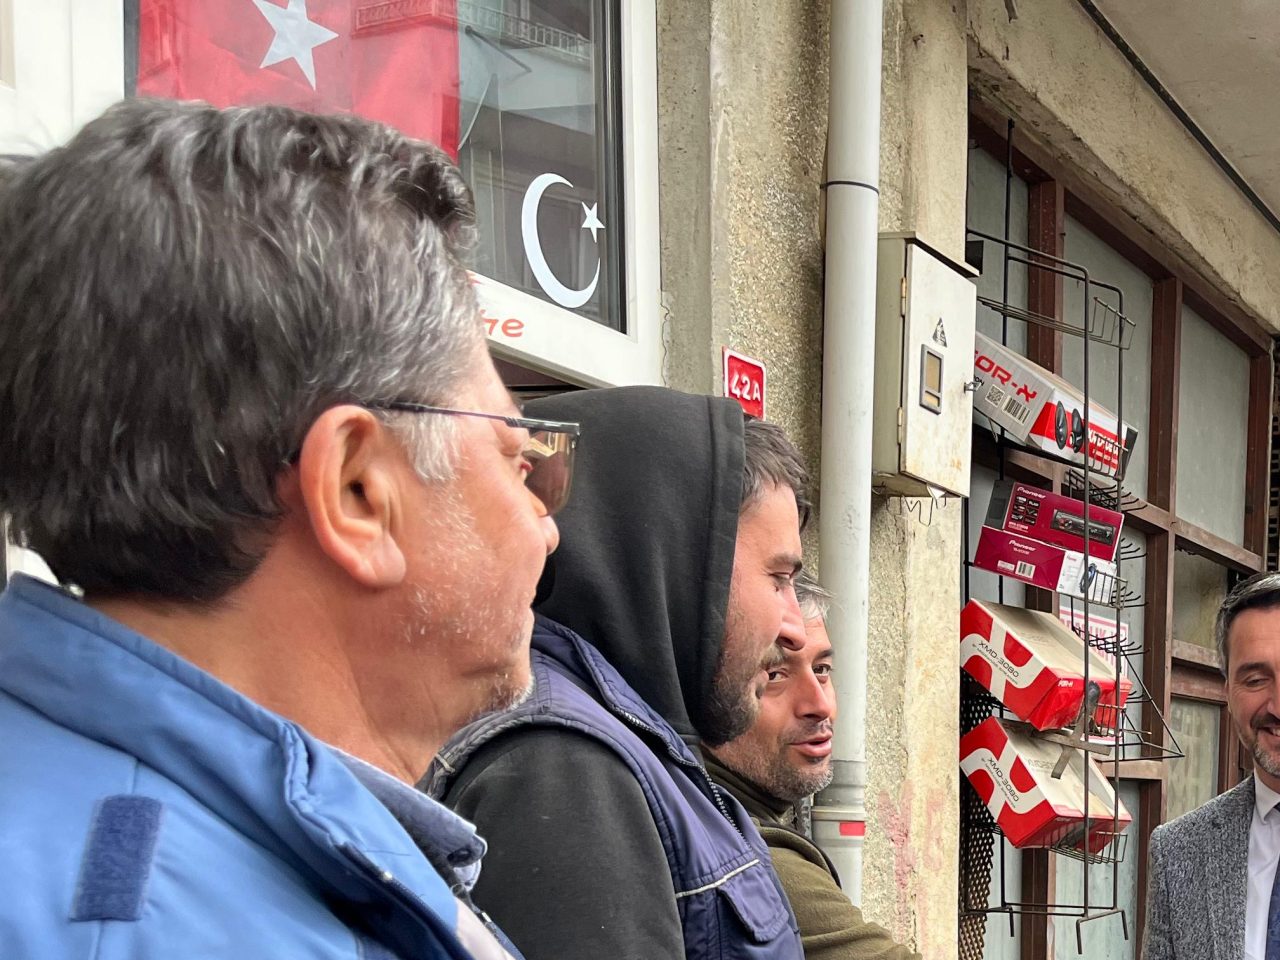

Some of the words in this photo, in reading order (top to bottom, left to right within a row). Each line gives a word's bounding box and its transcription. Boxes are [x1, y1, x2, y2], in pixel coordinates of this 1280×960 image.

[731, 371, 761, 402] 42A
[975, 350, 1037, 403] OR-X
[1016, 486, 1046, 499] Pioneer
[1008, 539, 1036, 552] Pioneer
[978, 640, 1020, 678] XMD-3080
[987, 757, 1020, 802] XMD-3080
